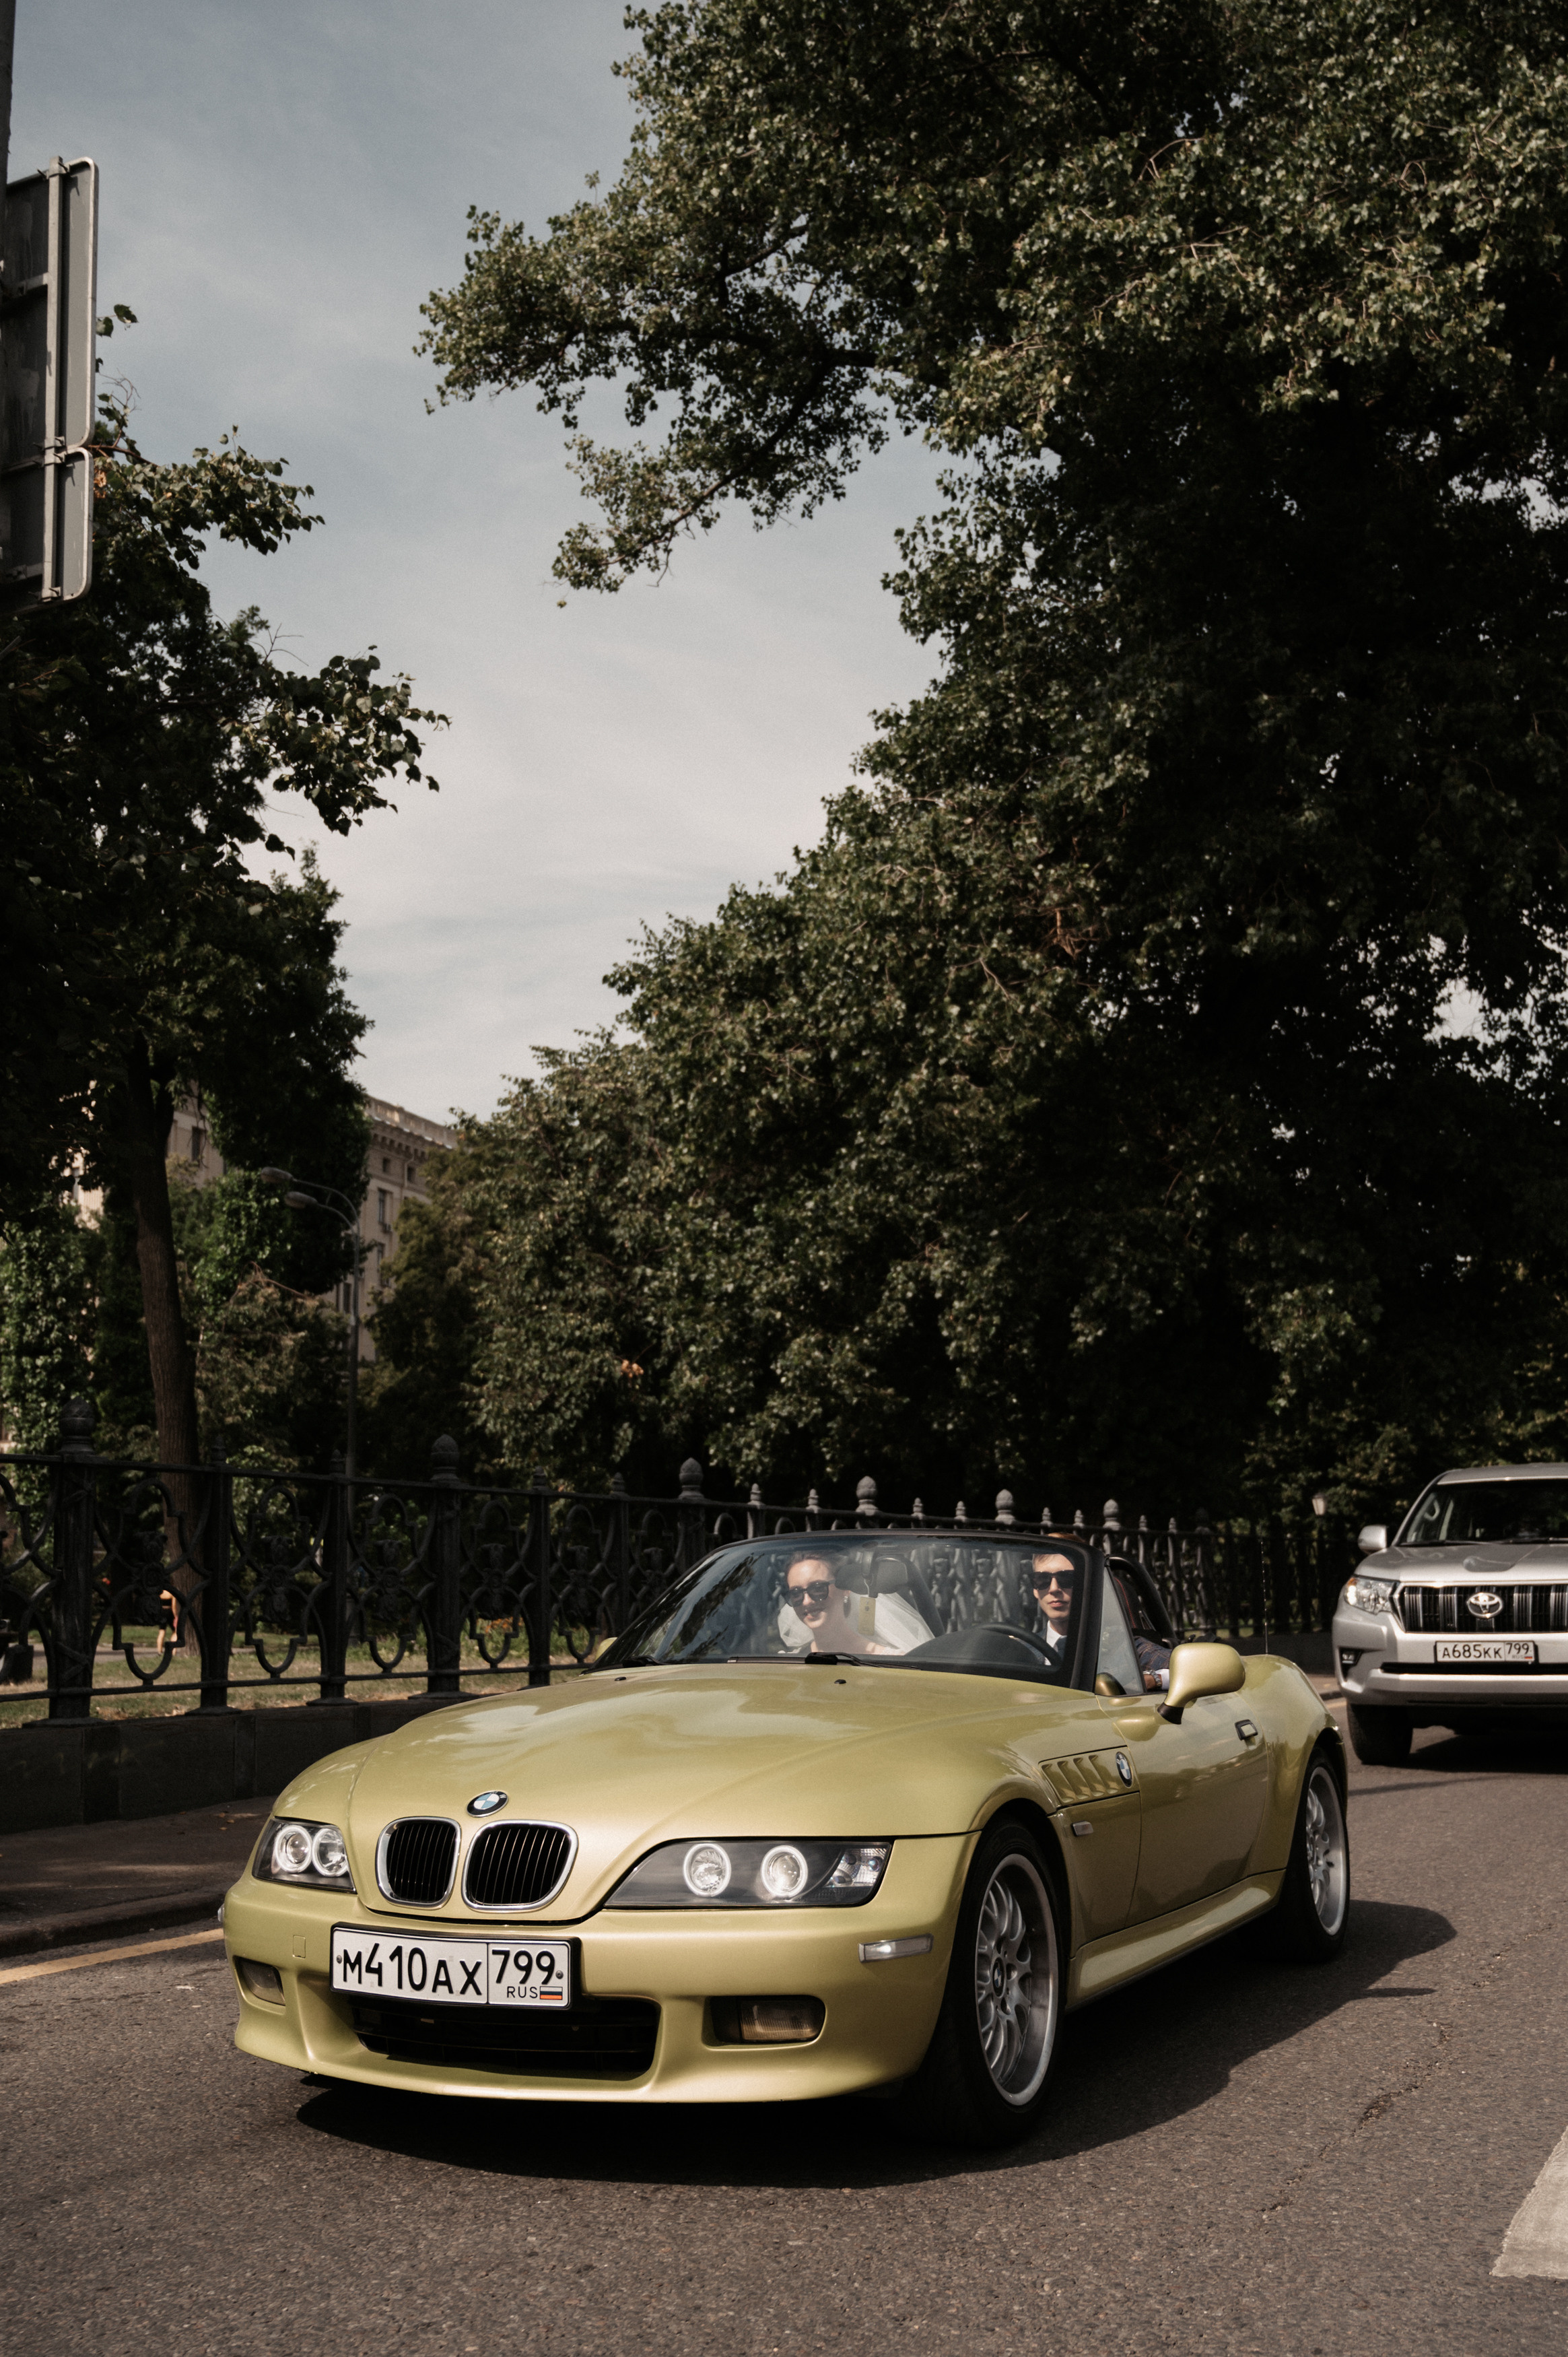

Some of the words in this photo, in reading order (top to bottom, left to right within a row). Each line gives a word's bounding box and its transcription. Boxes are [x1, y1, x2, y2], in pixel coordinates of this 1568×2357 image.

[1505, 1642, 1530, 1655] 799
[491, 1949, 555, 1985] 799
[506, 1986, 538, 1999] RUS
